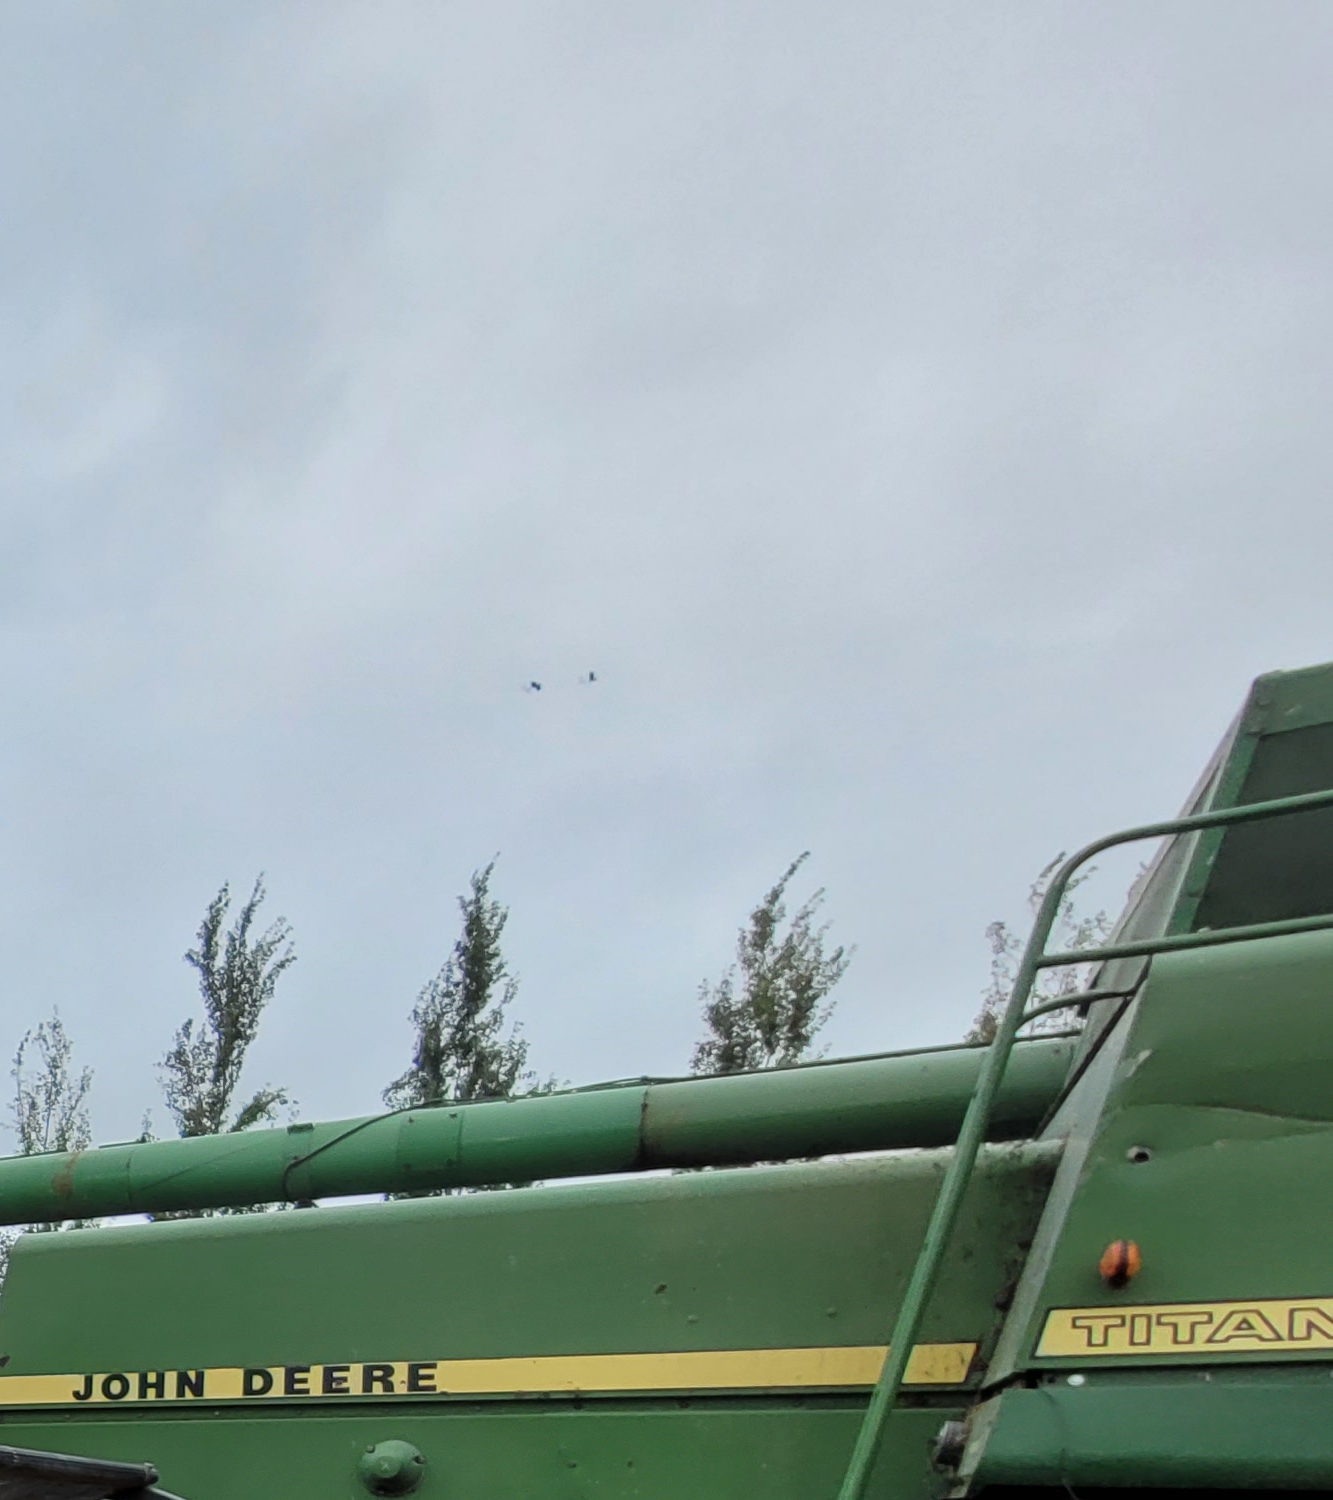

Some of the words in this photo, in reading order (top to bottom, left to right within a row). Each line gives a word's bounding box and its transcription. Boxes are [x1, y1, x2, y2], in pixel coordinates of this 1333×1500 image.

[1071, 1306, 1333, 1347] TITAN
[72, 1369, 205, 1401] JOHN
[242, 1362, 438, 1397] DEERE
